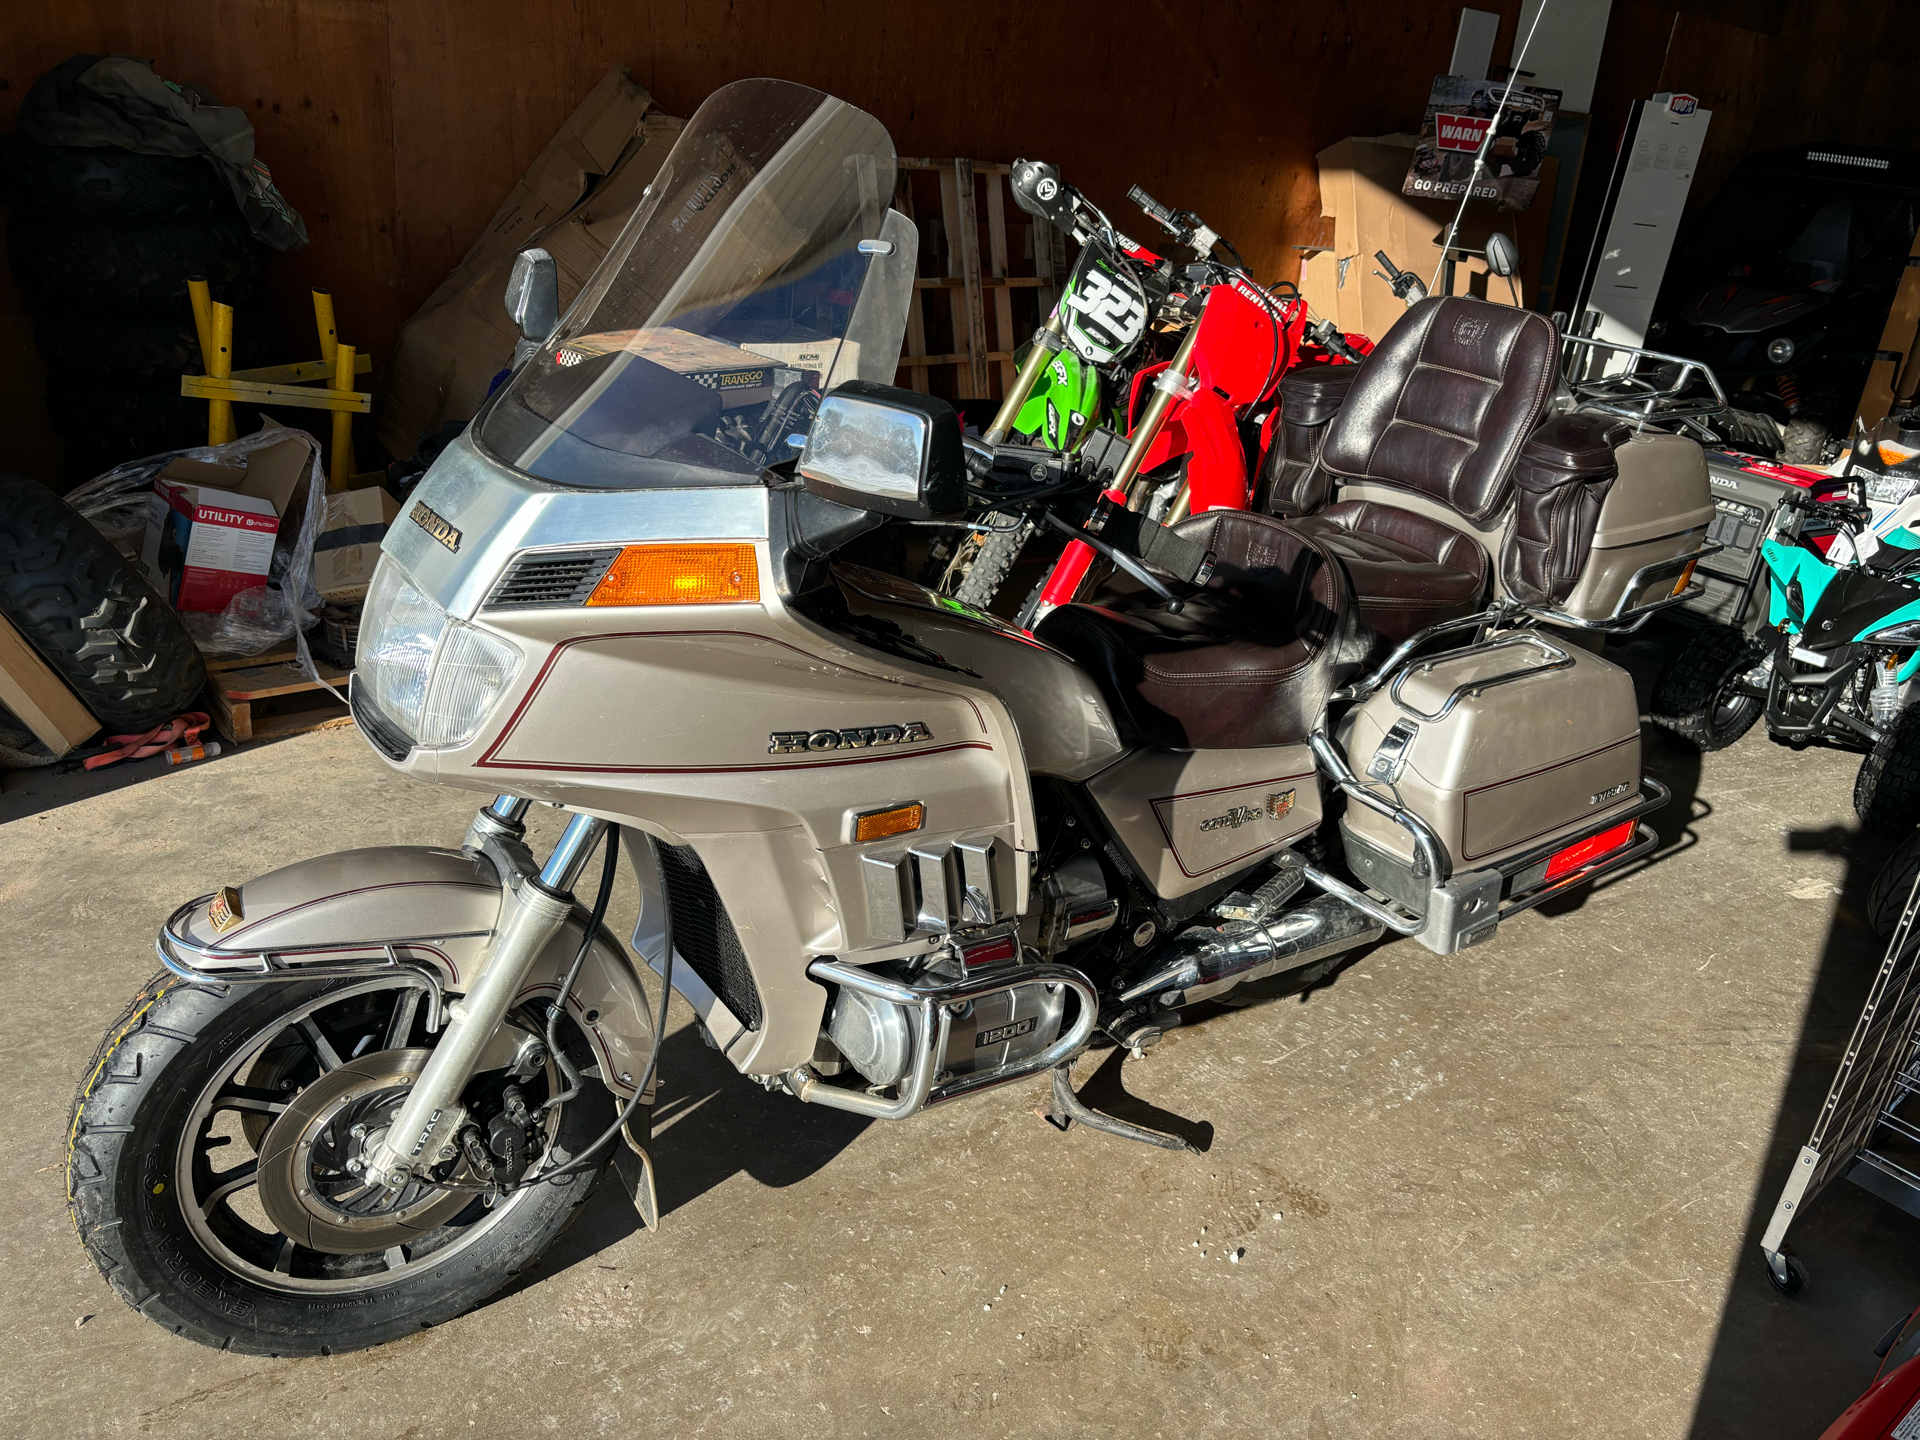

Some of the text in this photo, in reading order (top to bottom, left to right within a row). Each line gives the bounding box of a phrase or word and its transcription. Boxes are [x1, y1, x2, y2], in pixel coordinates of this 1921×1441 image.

[1671, 98, 1696, 113] 100%
[1440, 124, 1483, 142] WARN
[1414, 179, 1498, 199] GO PREPARED
[1065, 269, 1146, 344] 323
[1709, 475, 1738, 490] NDA
[198, 509, 245, 525] UTILITY
[410, 500, 462, 554] HONDA
[768, 721, 931, 754] HONDA
[983, 1019, 1031, 1045] 1200
[411, 1109, 442, 1156] TRAC
[156, 1234, 256, 1319] EXEDRA
